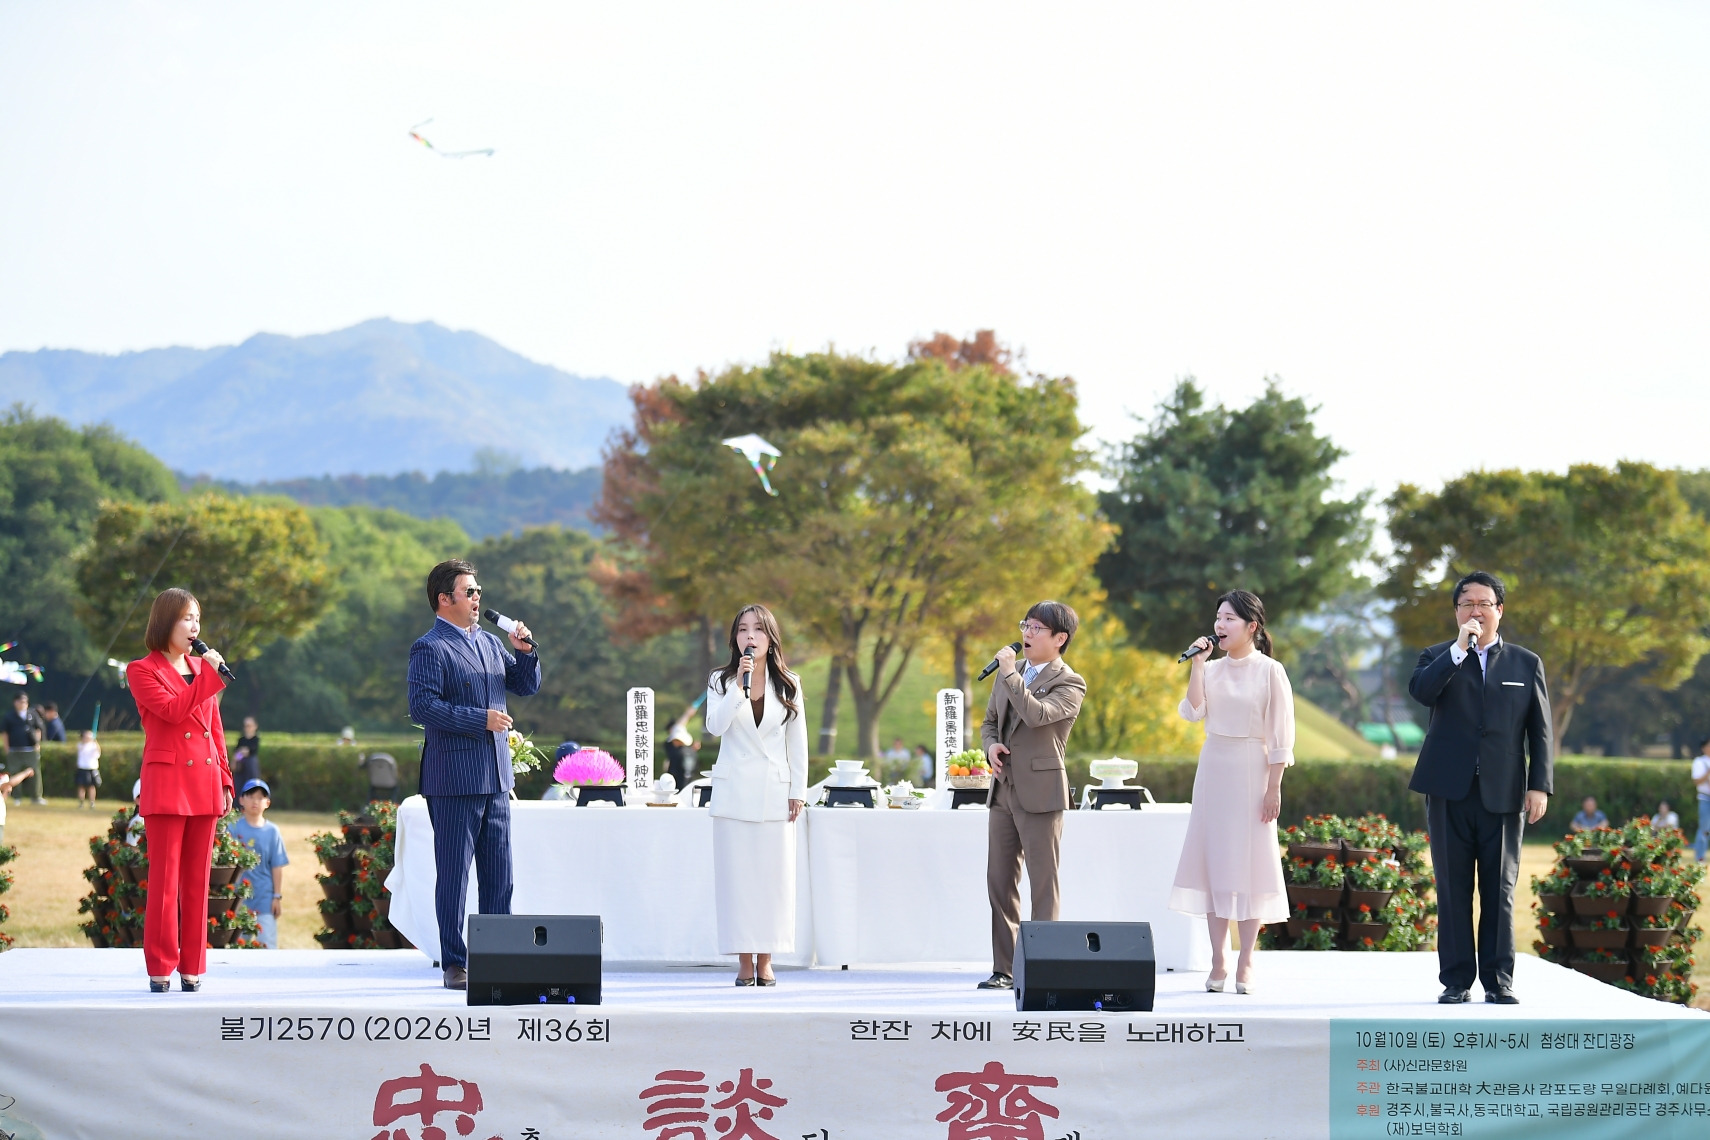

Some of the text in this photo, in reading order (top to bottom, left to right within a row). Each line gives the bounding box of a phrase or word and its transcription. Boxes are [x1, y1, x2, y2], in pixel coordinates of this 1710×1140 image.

[516, 1018, 610, 1043] 제36회
[849, 1019, 1245, 1044] 한잔 차에 安民을 노래하고
[1540, 1032, 1579, 1050] 첨성대
[1583, 1032, 1637, 1050] 잔디광장
[1356, 1058, 1468, 1073] 주최 (사)신라문화원
[1356, 1082, 1381, 1094] 주관
[1386, 1082, 1473, 1096] 한국불교대학
[1539, 1082, 1597, 1096] 감포도량
[1356, 1104, 1381, 1117] 후원
[1547, 1102, 1652, 1118] 국립공원관리공단
[1655, 1102, 1710, 1118] 경주사무
[1386, 1121, 1464, 1137] (재)보덕학회
